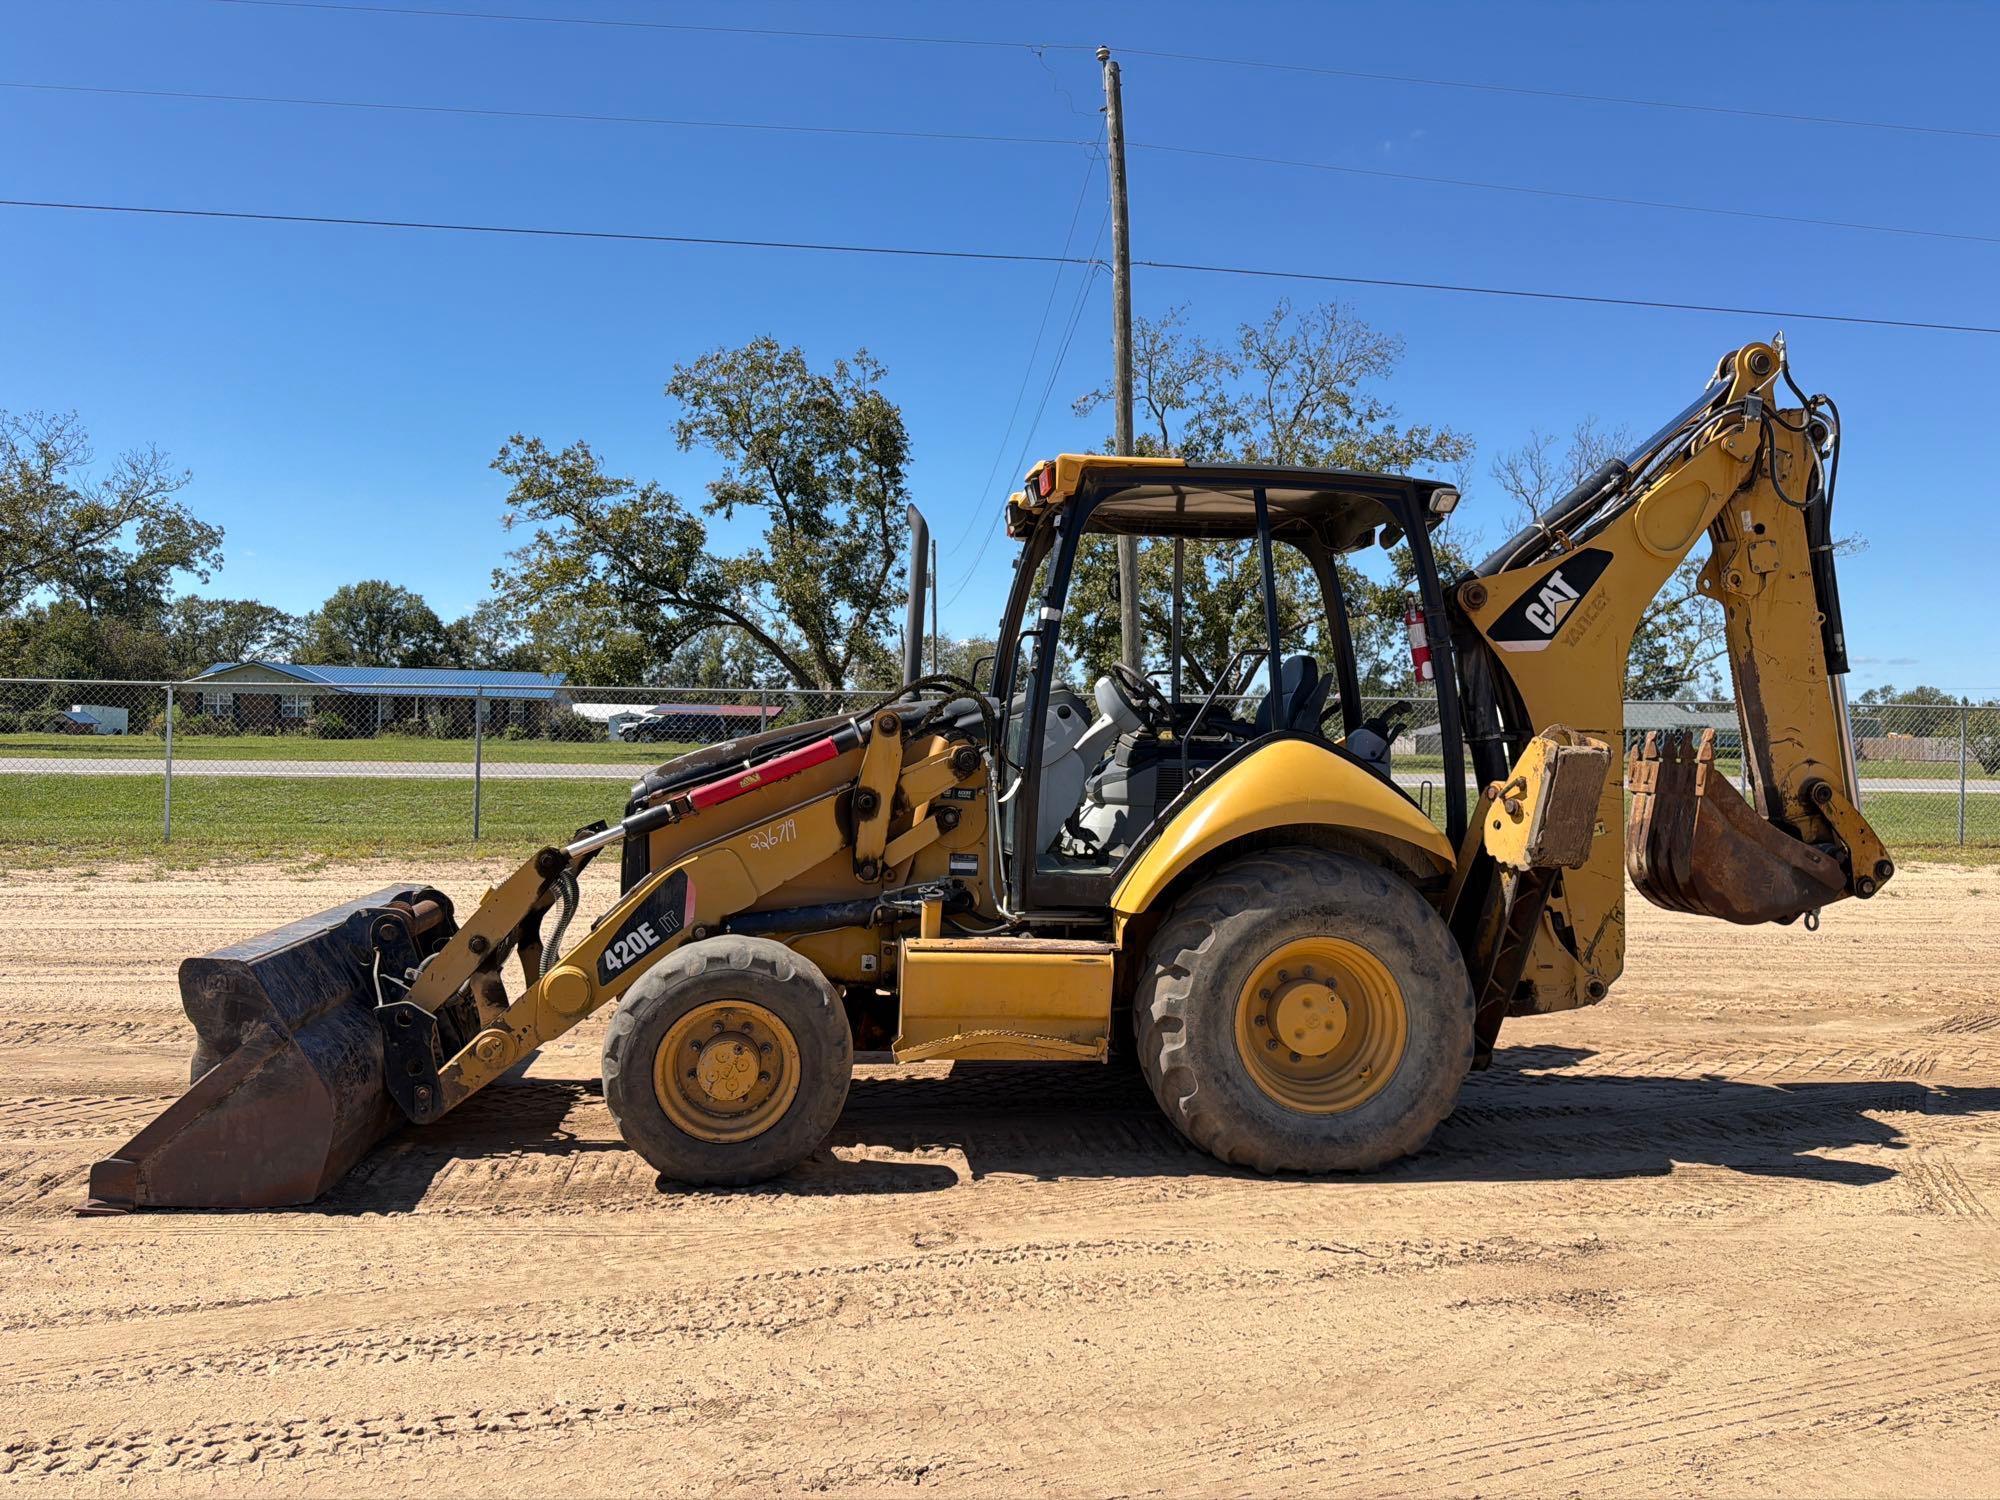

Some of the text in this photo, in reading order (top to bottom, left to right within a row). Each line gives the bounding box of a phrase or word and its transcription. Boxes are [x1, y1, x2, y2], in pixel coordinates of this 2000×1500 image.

[1525, 570, 1580, 634] CAT
[748, 819, 796, 851] 226719
[605, 910, 680, 971] 420E IT
